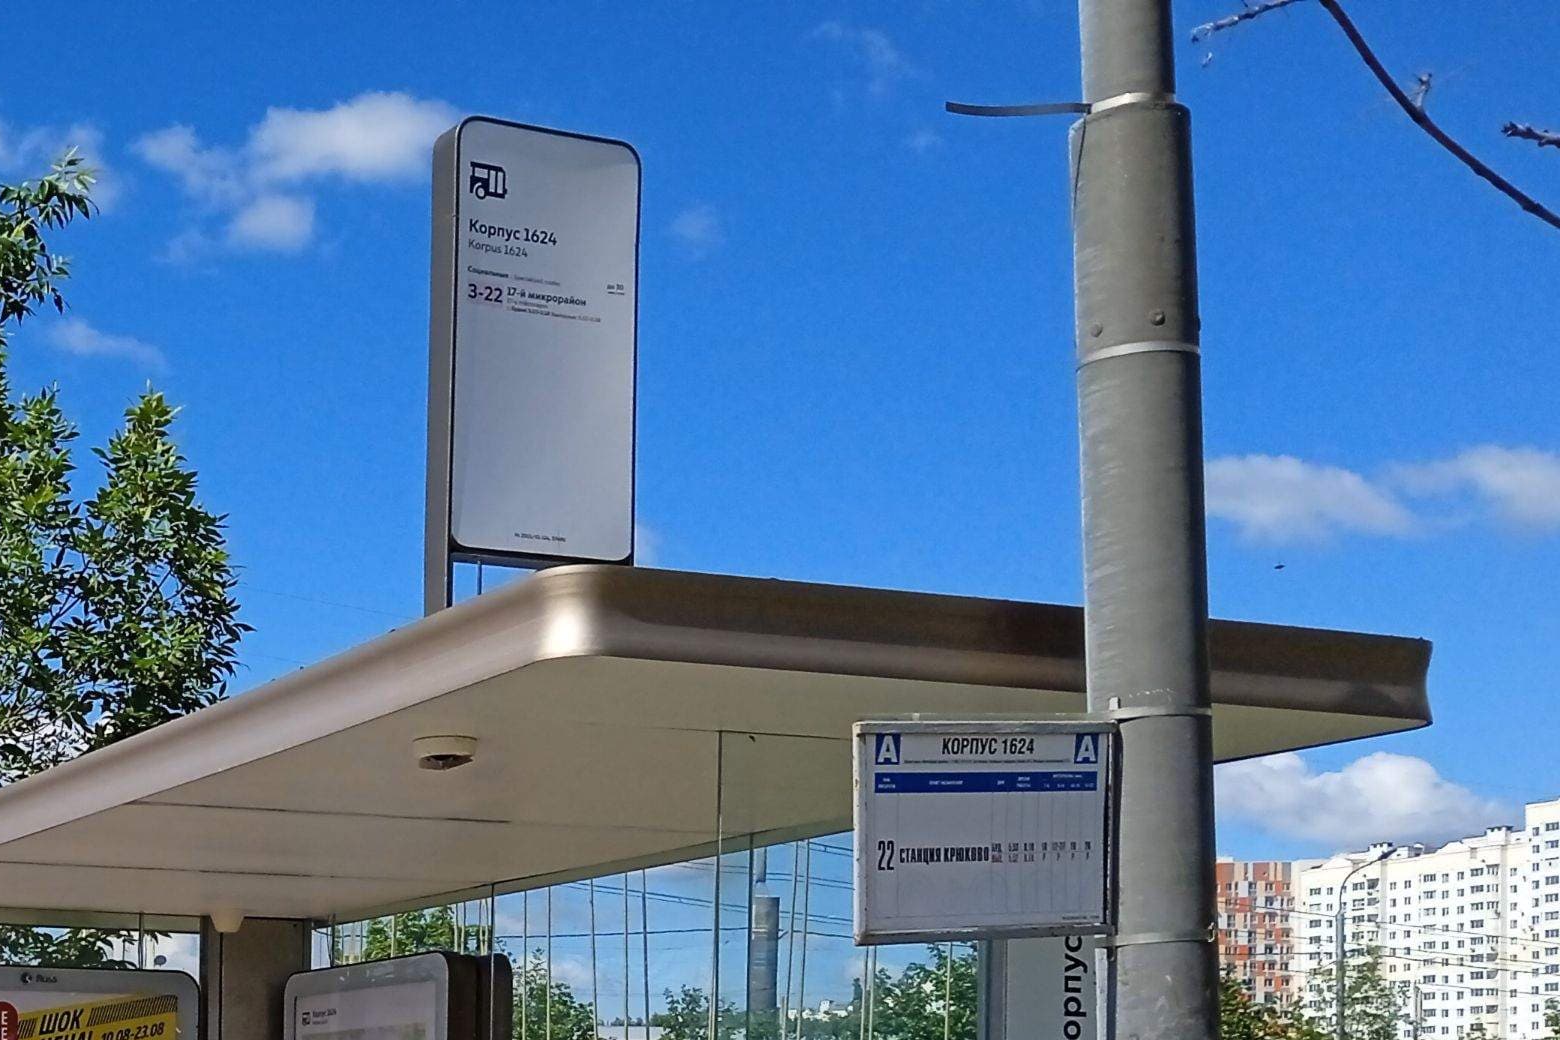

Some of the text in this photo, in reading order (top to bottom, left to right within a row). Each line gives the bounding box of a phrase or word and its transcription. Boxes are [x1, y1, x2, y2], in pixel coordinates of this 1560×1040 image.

[469, 219, 557, 246] Корпус 1624
[468, 239, 528, 258] Korpus 1624
[528, 291, 586, 306] микрорайон
[877, 735, 898, 763] А
[942, 738, 1034, 755] КОРПУС 1624
[1076, 735, 1096, 762] А
[878, 840, 894, 870] 22
[899, 847, 941, 865] СТАНЦИЯ
[944, 846, 989, 862] КРЮКОВО
[40, 1008, 84, 1036] ШОК
